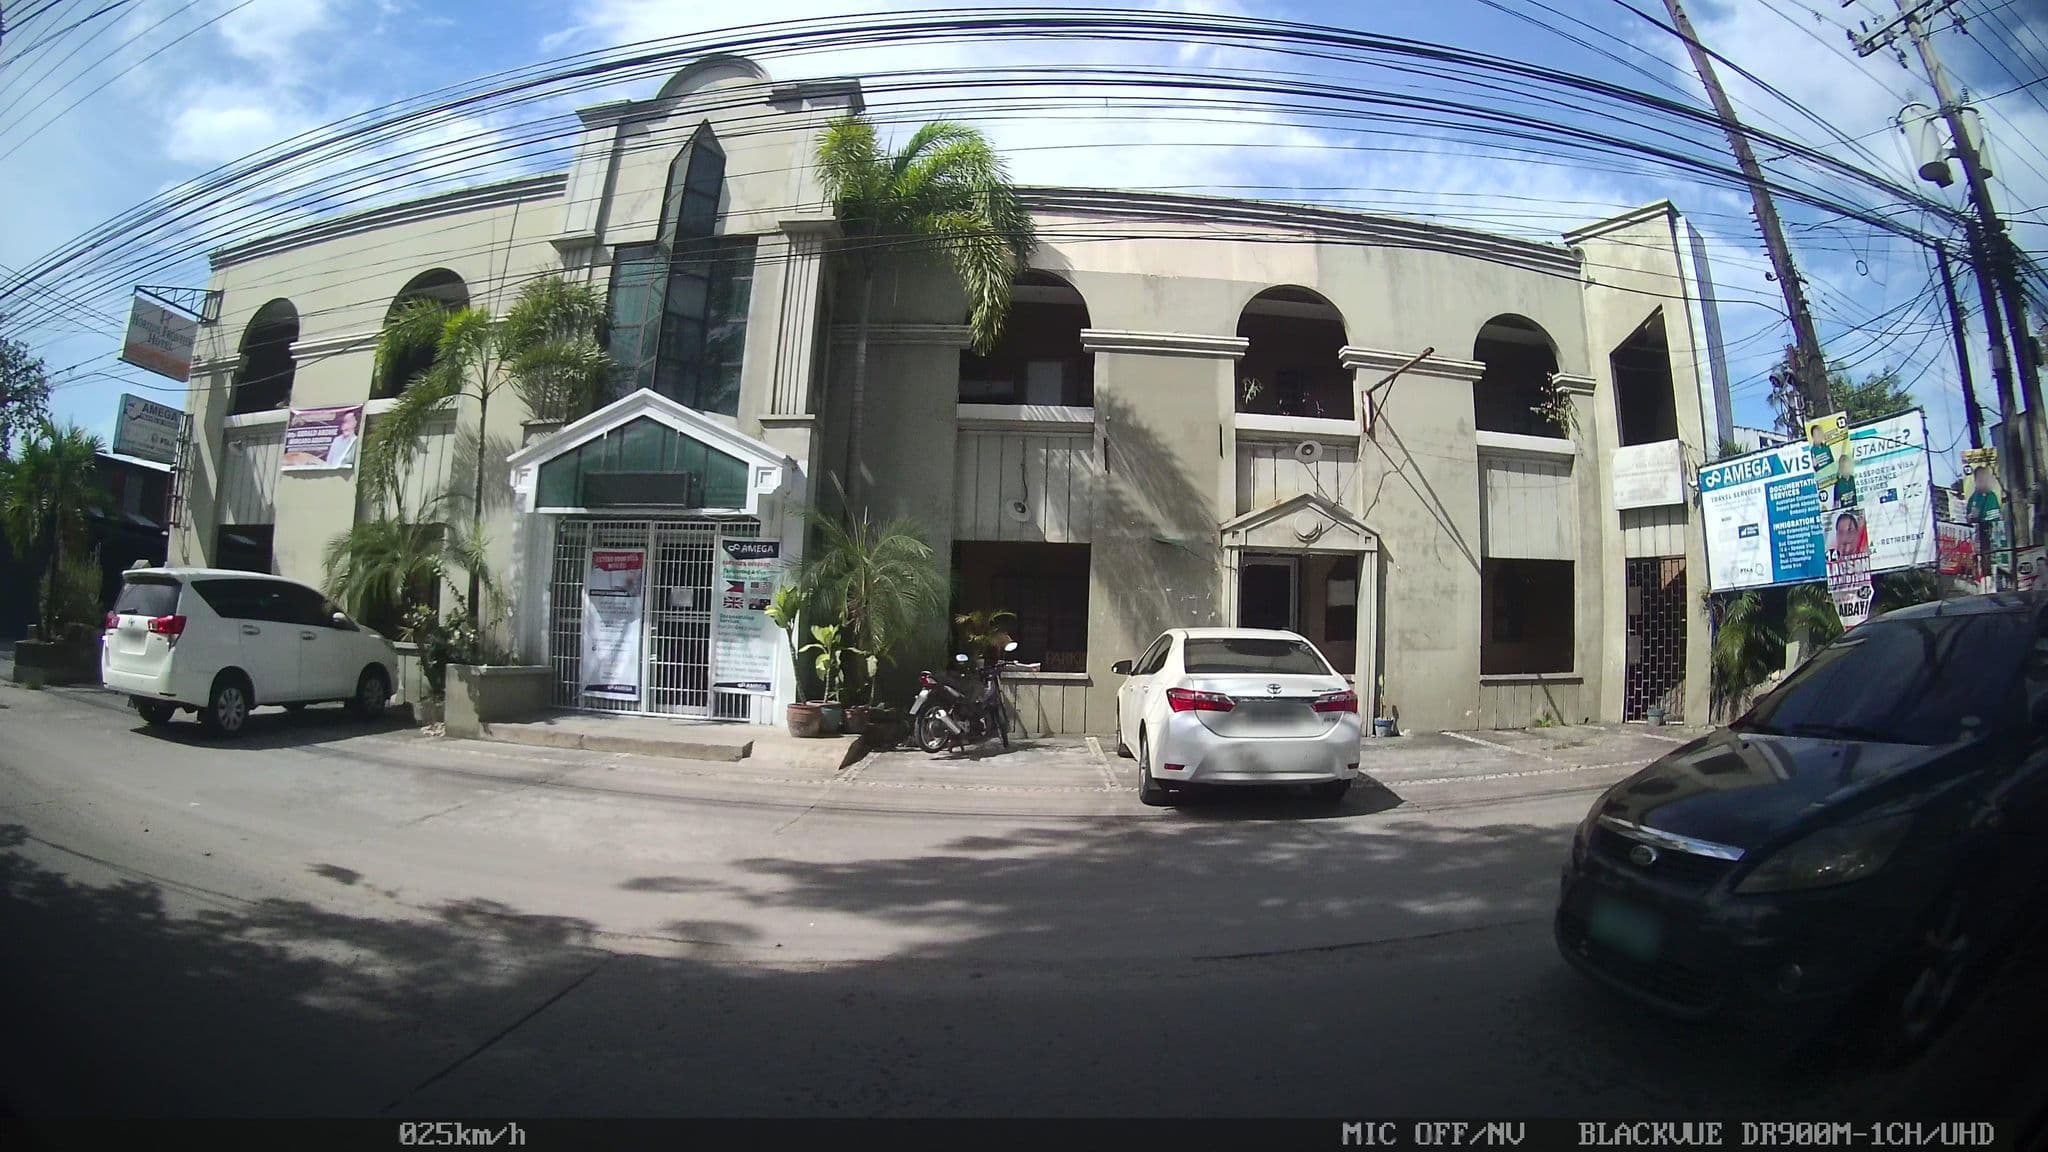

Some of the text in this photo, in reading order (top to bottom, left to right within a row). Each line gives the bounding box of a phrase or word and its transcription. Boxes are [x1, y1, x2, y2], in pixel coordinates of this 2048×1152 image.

[142, 403, 178, 421] AMEGA
[1724, 458, 1772, 483] AMEGA
[1711, 487, 1761, 503] TRAVEL SERVICES
[1770, 488, 1800, 500] SERVICES
[1773, 517, 1815, 530] IMMIGRATION
[1881, 531, 1924, 544] RETIREMENT
[741, 544, 774, 553] AMEGA
